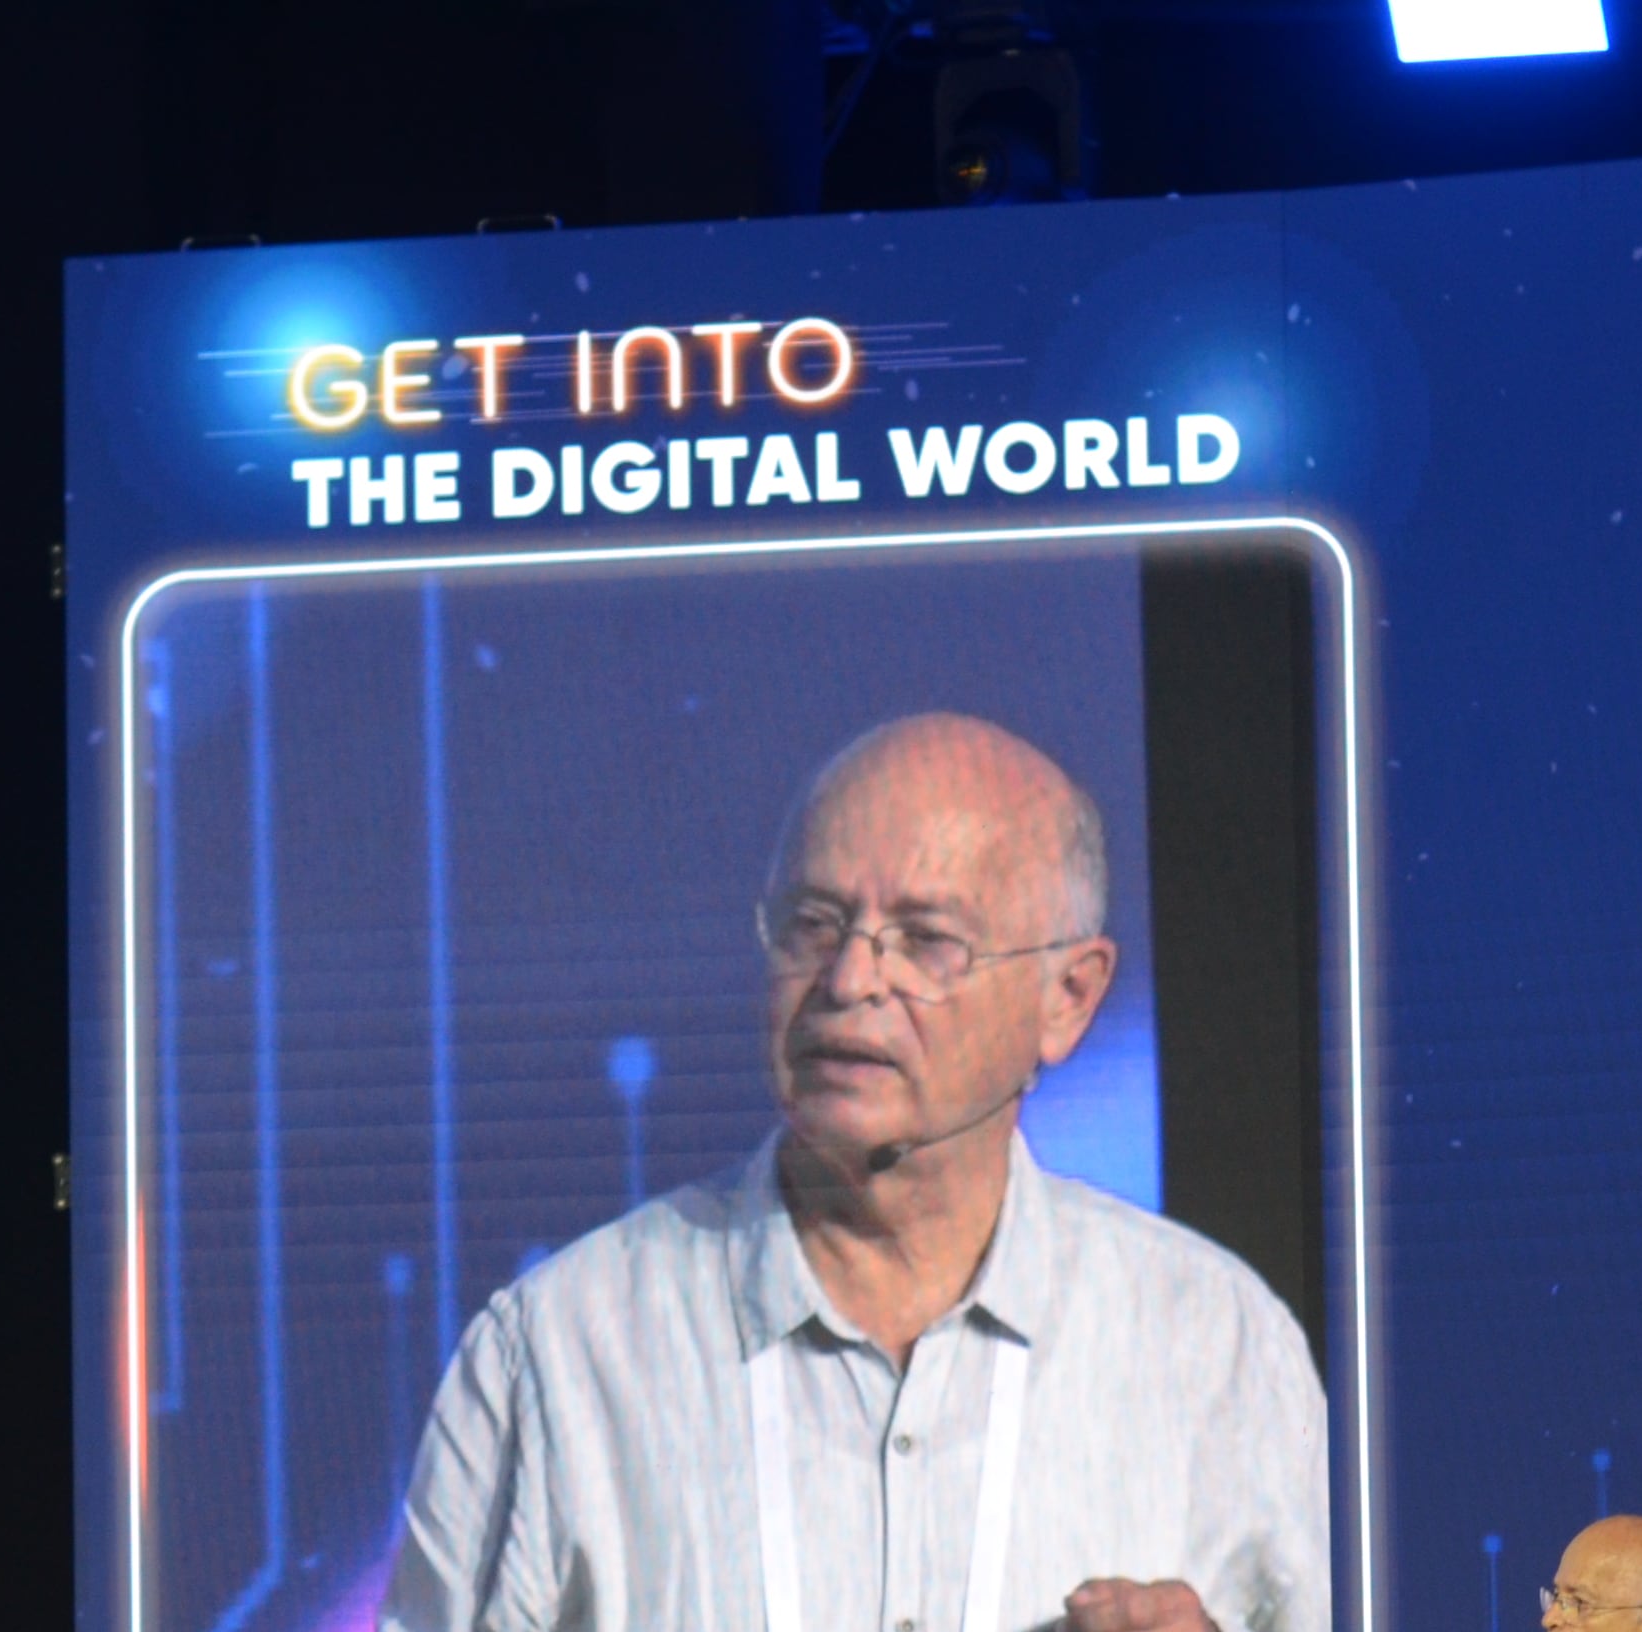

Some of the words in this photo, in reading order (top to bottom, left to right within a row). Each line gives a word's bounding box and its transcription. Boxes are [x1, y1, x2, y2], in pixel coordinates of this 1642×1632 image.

[289, 333, 524, 427] GET
[578, 316, 854, 413] INTO
[291, 450, 461, 528] THE
[491, 434, 860, 518] DIGITAL
[889, 413, 1241, 496] WORLD
